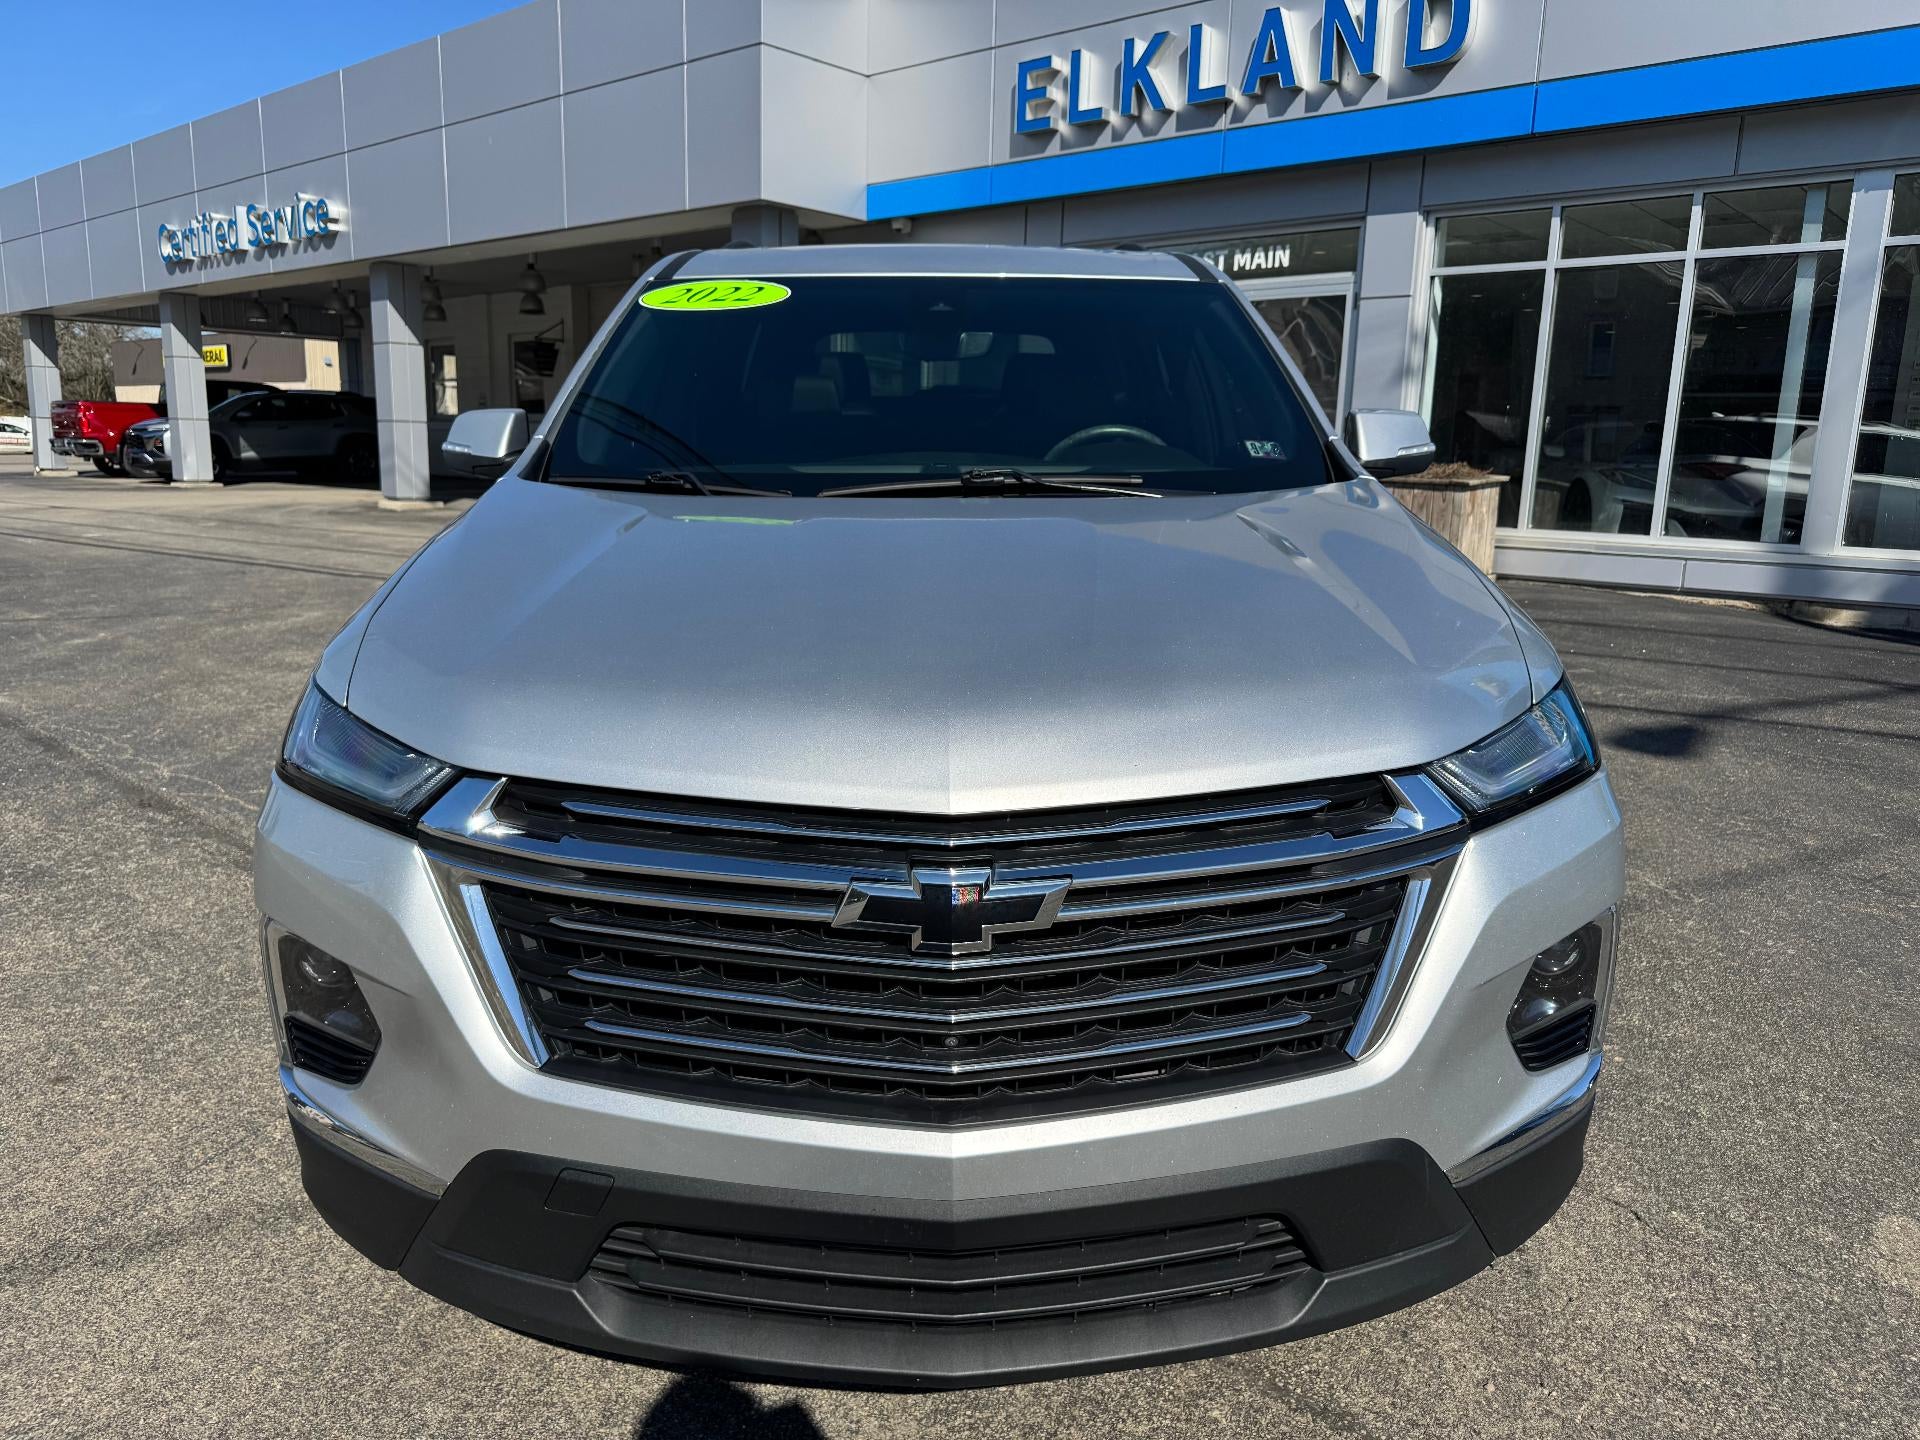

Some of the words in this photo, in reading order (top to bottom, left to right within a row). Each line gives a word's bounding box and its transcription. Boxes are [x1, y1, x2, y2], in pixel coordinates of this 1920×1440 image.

[1015, 0, 1471, 134] ELKLAND
[158, 204, 240, 264] Certified
[246, 192, 330, 248] Service
[1192, 249, 1228, 272] ST
[1233, 244, 1291, 272] MAIN
[659, 286, 766, 305] 2022
